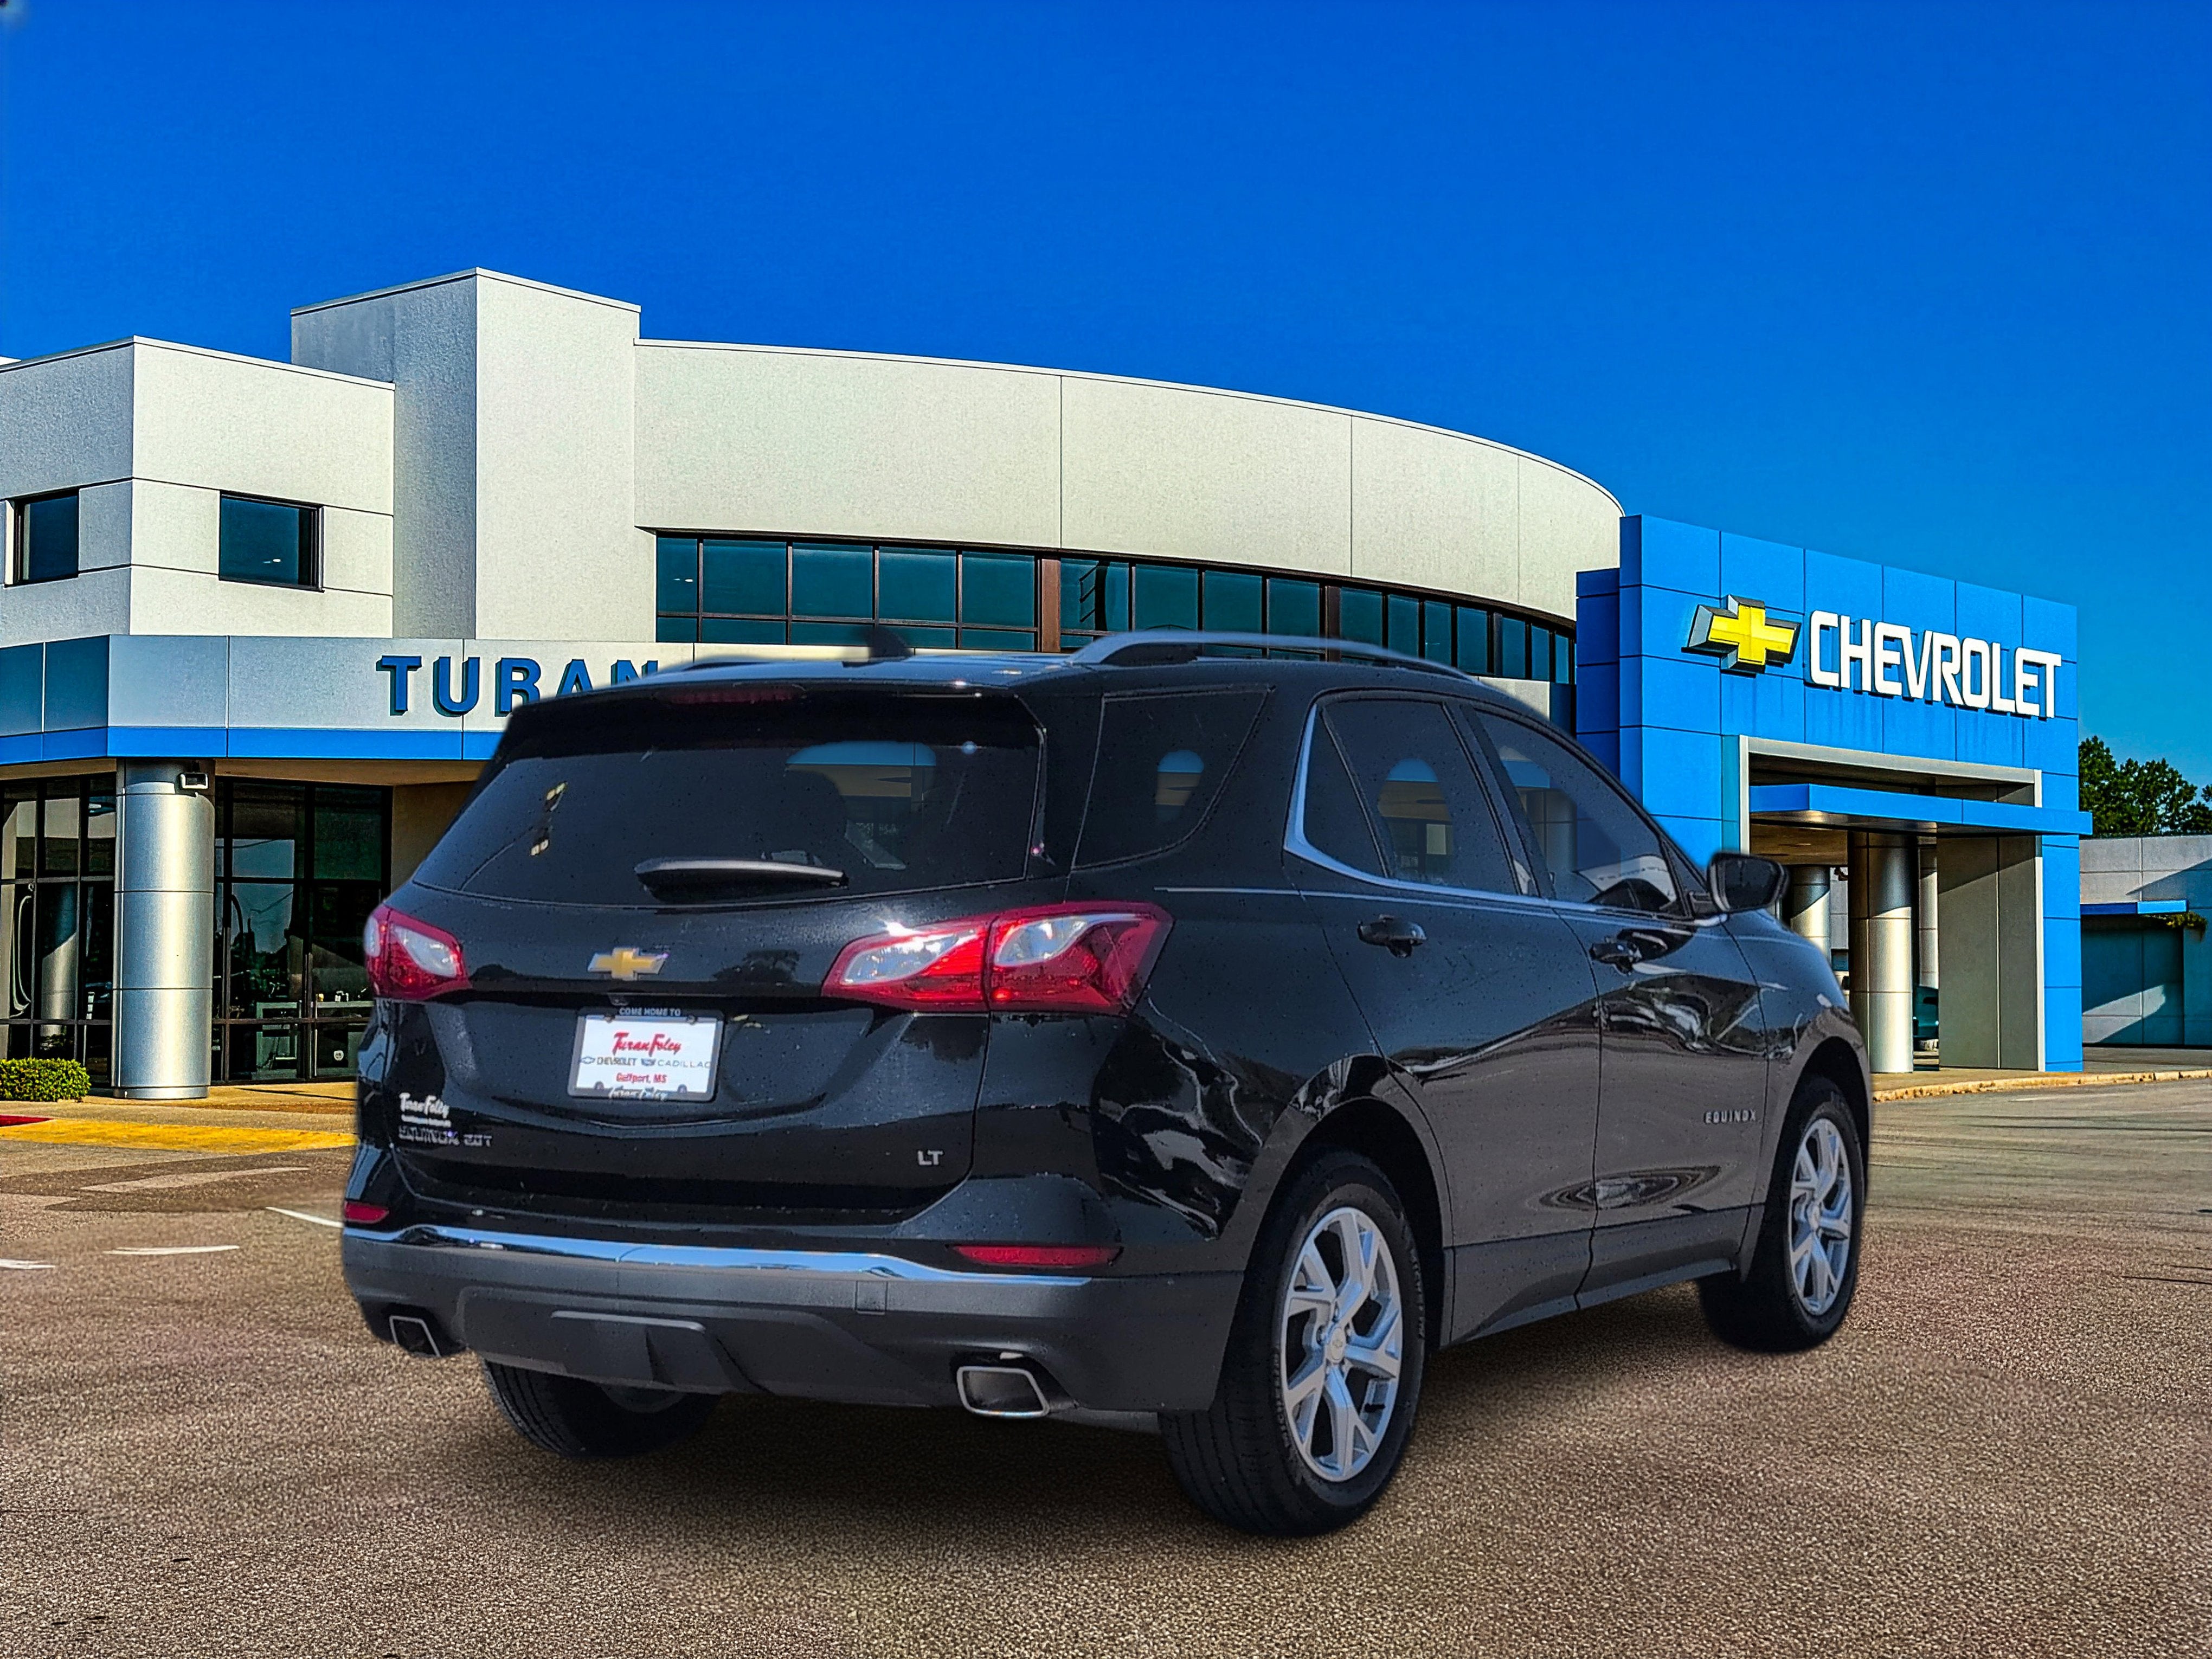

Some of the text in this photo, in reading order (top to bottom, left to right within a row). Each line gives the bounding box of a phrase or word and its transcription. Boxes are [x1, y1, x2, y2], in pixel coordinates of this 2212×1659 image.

[1809, 610, 2062, 718] CHEVROLET
[619, 1007, 681, 1017] COME HOME TO
[657, 1059, 710, 1068] CADILLAC
[653, 1073, 667, 1083] MS
[1705, 1110, 1756, 1124] EQUINOX
[917, 1150, 944, 1166] LT
